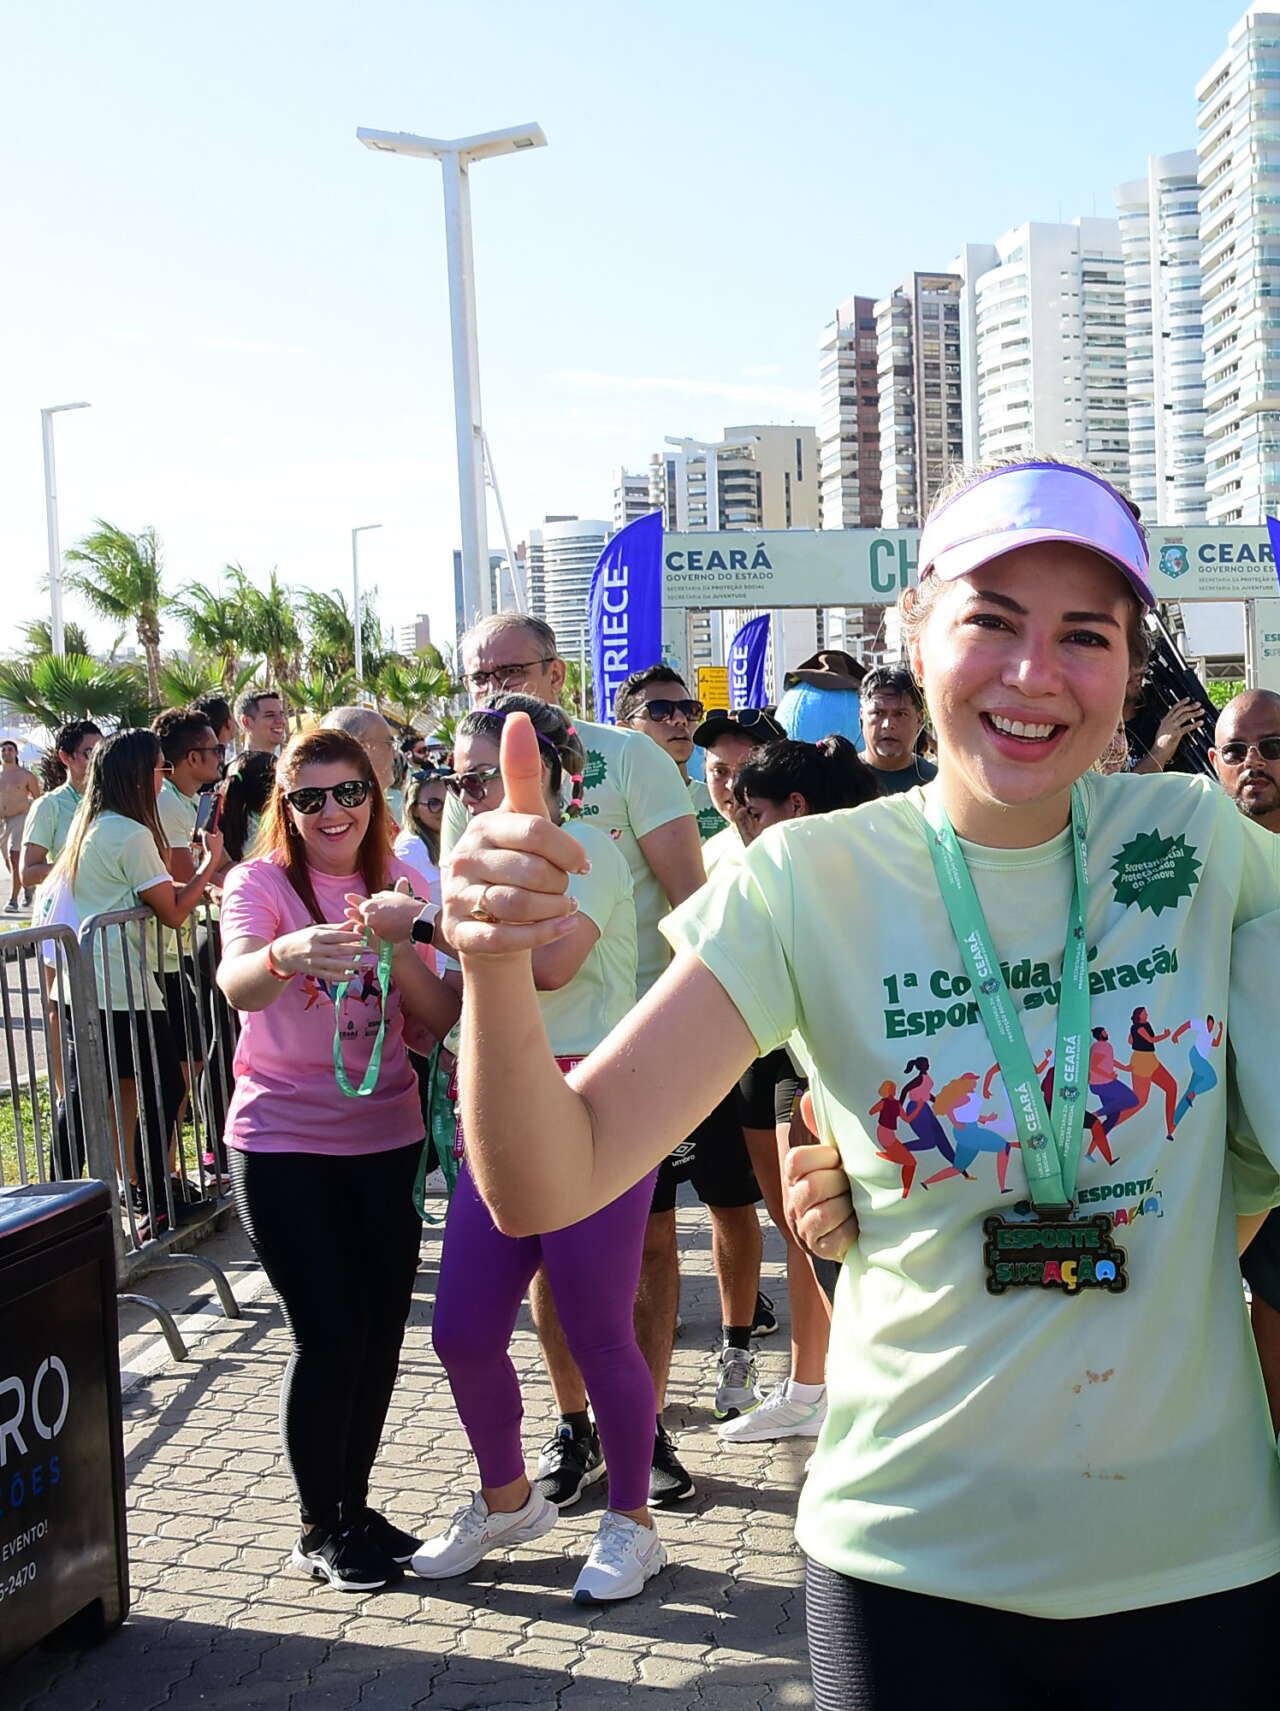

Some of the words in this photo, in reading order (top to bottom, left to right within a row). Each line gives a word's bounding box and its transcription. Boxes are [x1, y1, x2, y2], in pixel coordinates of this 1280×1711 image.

[665, 542, 773, 571] CEARÁ
[1198, 543, 1275, 563] CEAR
[1247, 565, 1261, 573] DO
[666, 574, 715, 582] GOVERNO
[718, 573, 732, 581] DO
[735, 572, 774, 581] ESTADO
[1124, 858, 1161, 873] Secretari
[964, 932, 988, 978] CEARÁ
[882, 971, 918, 1004] 1ª
[929, 957, 1052, 999] Coida
[883, 999, 980, 1039] Espor
[1022, 944, 1179, 1011] Sueração
[1063, 1035, 1076, 1082] CEARÁ
[1014, 1083, 1038, 1131] CEARÁ
[671, 1154, 696, 1167] umbro
[998, 1228, 1100, 1250] ESPORTE
[995, 1254, 1117, 1290] SUPERAÇÃO
[0, 1455, 62, 1517] ÕES
[2, 1519, 49, 1563] EVENTO!
